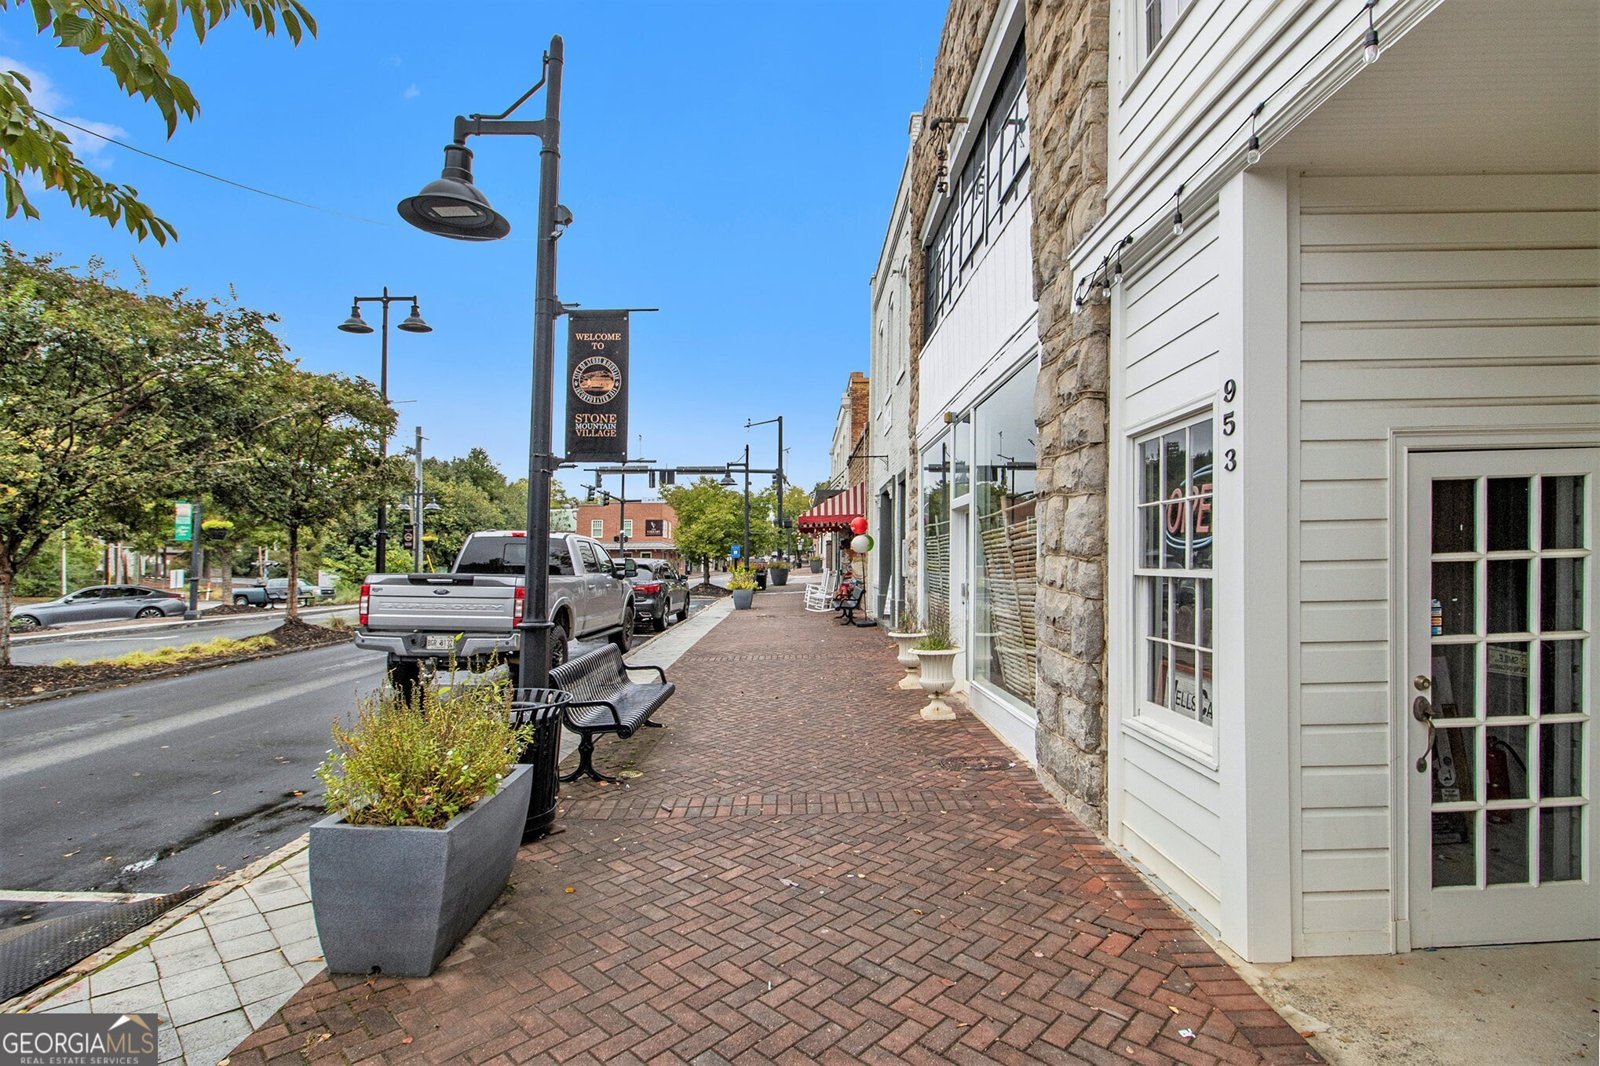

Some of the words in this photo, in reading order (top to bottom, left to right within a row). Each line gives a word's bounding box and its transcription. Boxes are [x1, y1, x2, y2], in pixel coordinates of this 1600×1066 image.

[591, 342, 605, 350] TO
[575, 413, 617, 424] STONE
[1168, 484, 1213, 533] OPE
